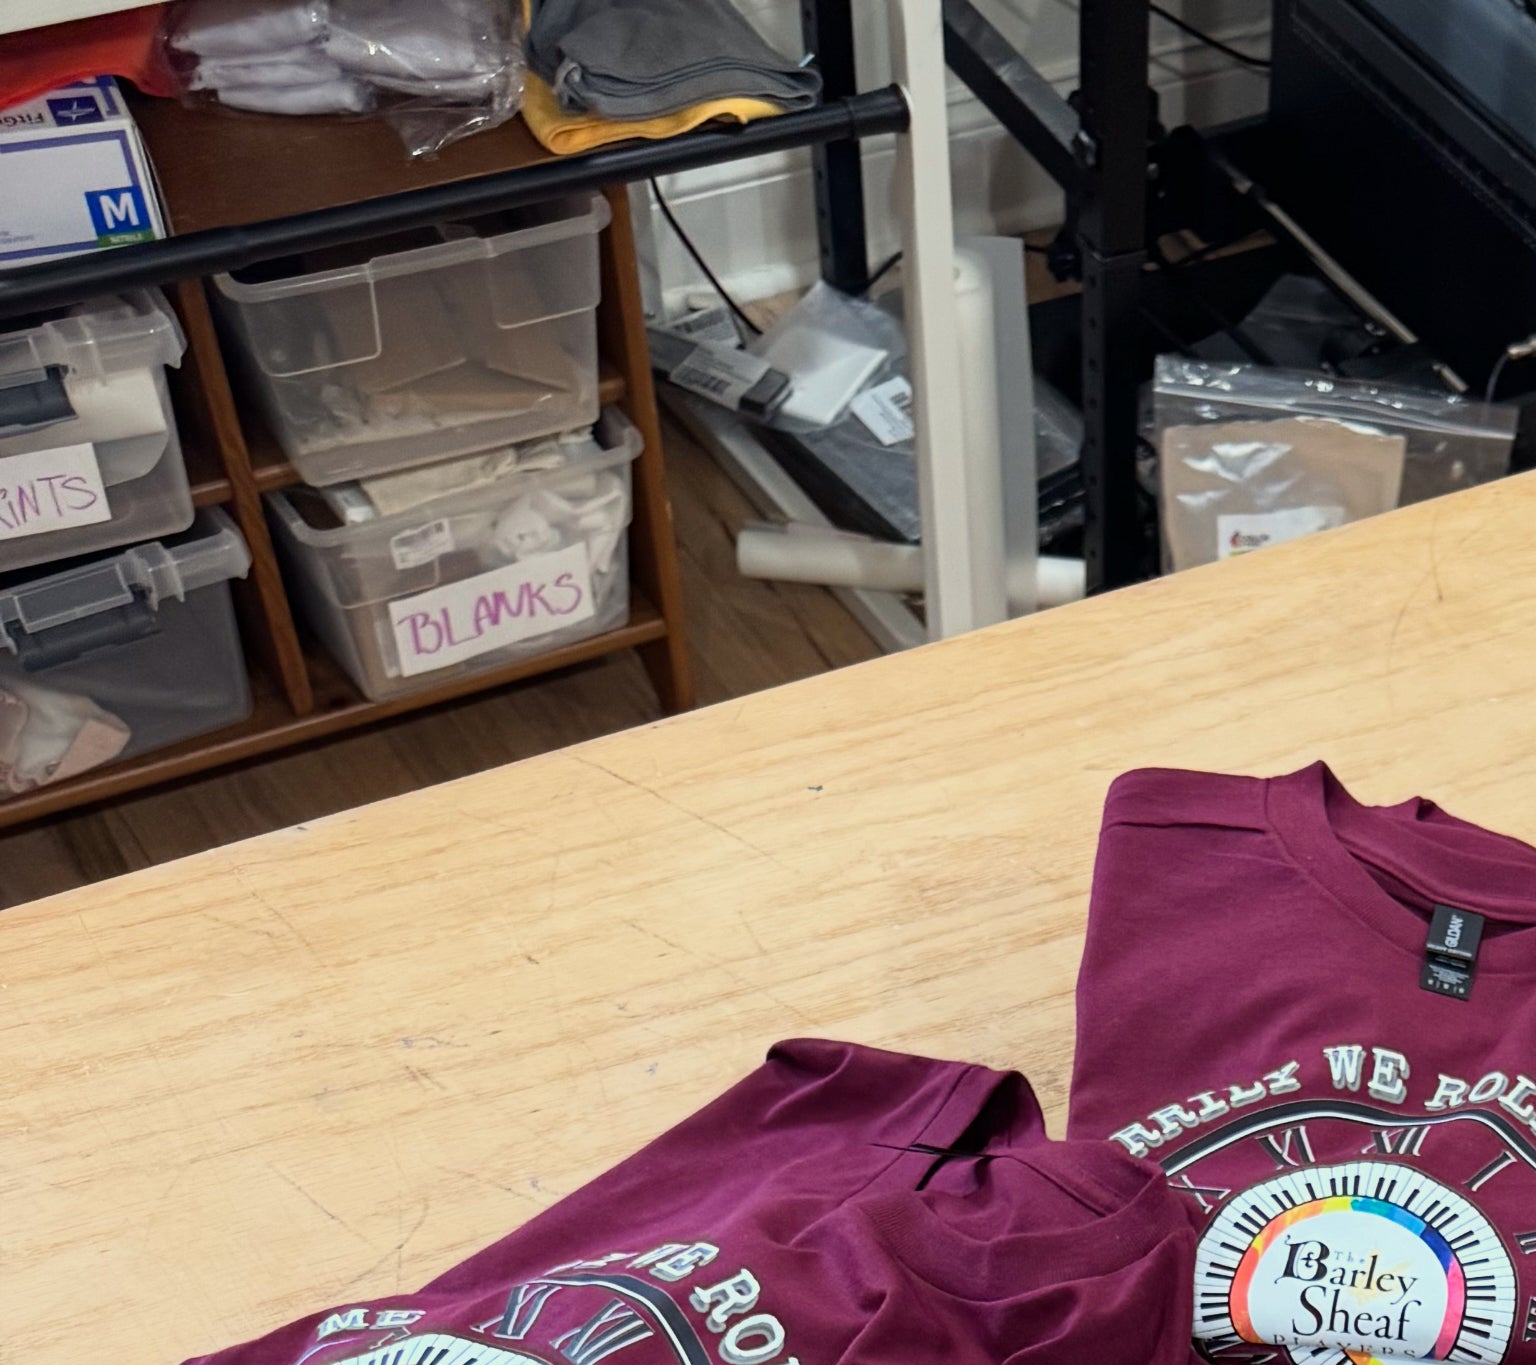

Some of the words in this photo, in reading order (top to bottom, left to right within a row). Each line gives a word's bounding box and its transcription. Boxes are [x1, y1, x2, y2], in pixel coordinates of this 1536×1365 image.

[0, 113, 44, 127] FitG
[99, 192, 140, 230] M
[397, 573, 582, 655] BLANKS
[1109, 1061, 1301, 1158] RRILY
[1323, 1045, 1410, 1105] WE
[1274, 1234, 1418, 1305] Barley
[1292, 1285, 1423, 1342] Sheaf
